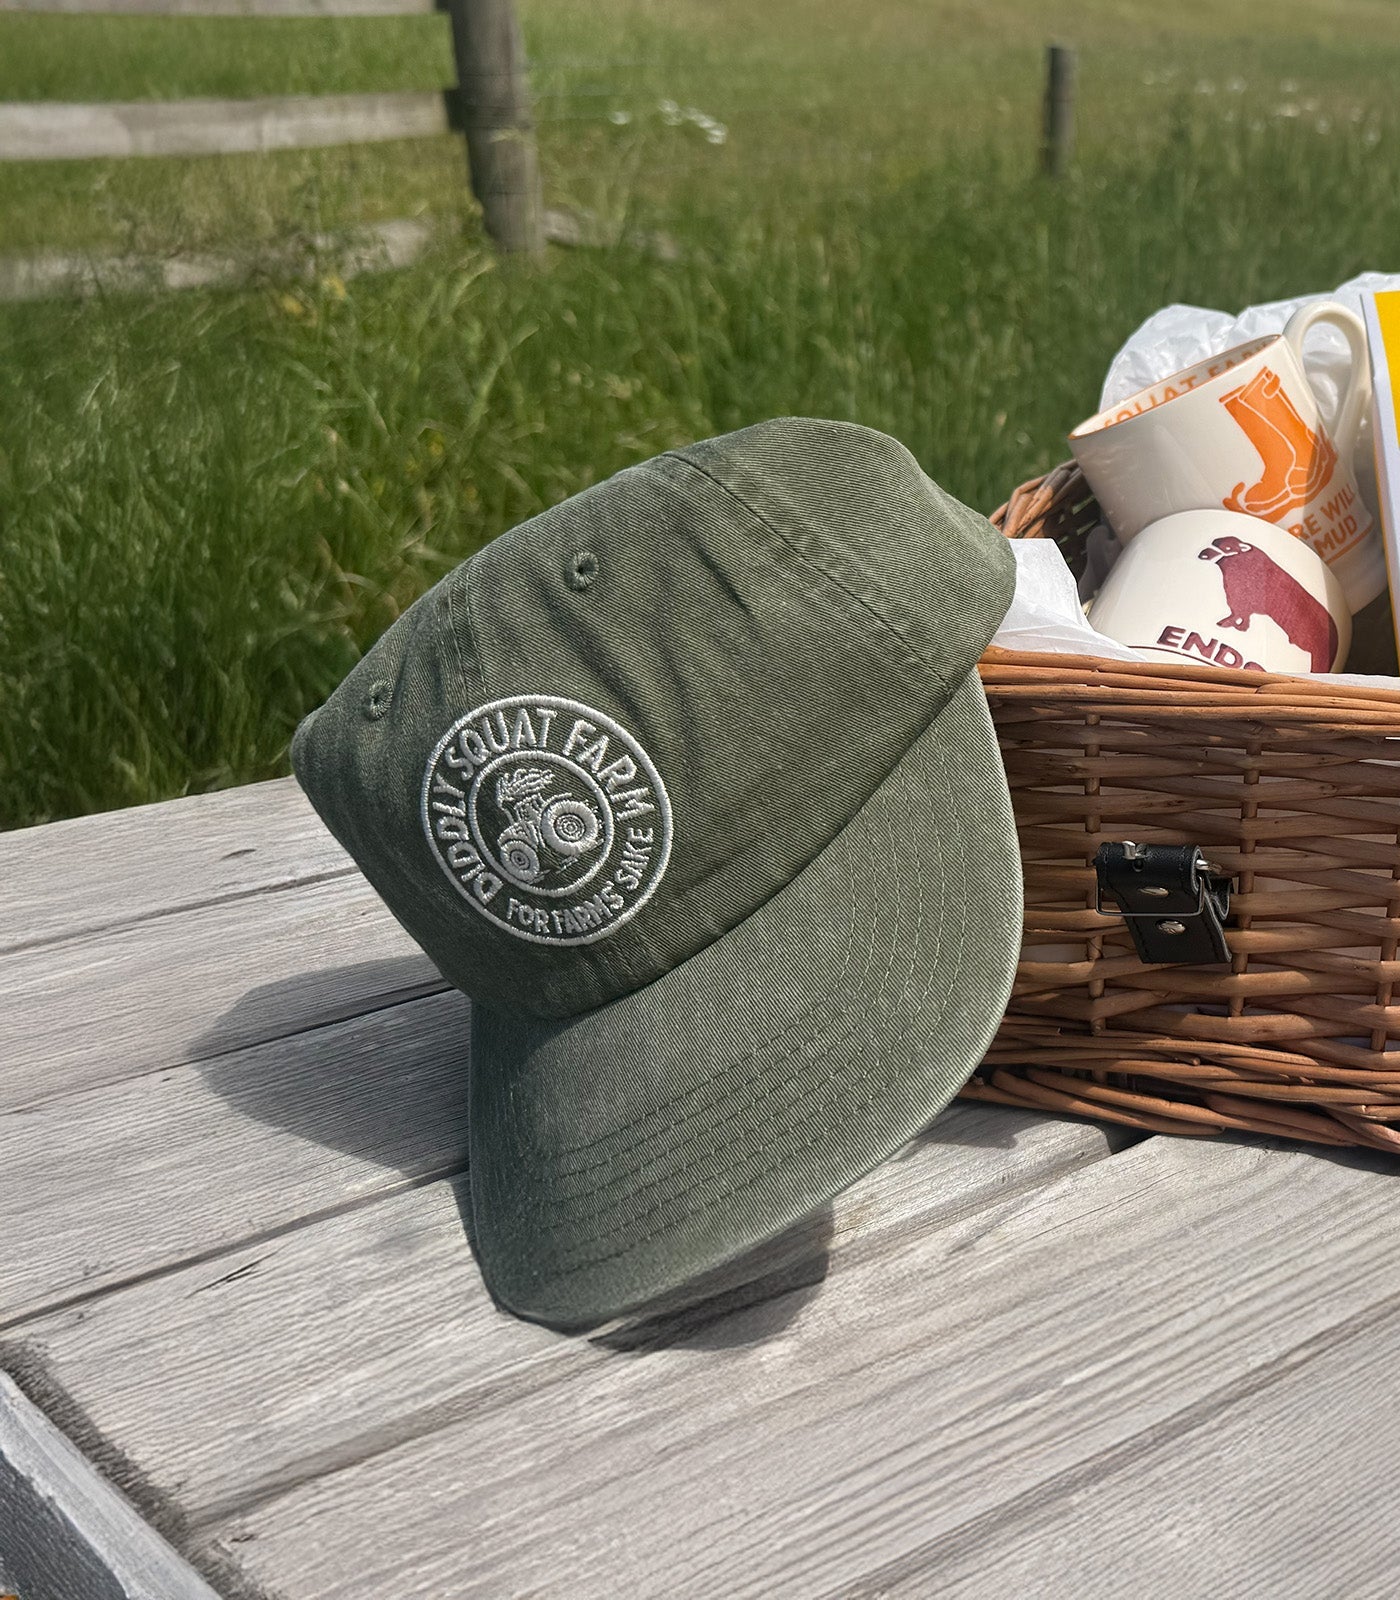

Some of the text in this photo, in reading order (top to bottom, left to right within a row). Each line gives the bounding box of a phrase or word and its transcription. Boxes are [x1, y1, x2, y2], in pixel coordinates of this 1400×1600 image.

[1313, 514, 1357, 558] MUD
[432, 708, 656, 905] DIDDLY SQUAT FARM
[506, 897, 550, 934] FOR
[614, 827, 654, 890] SAKE
